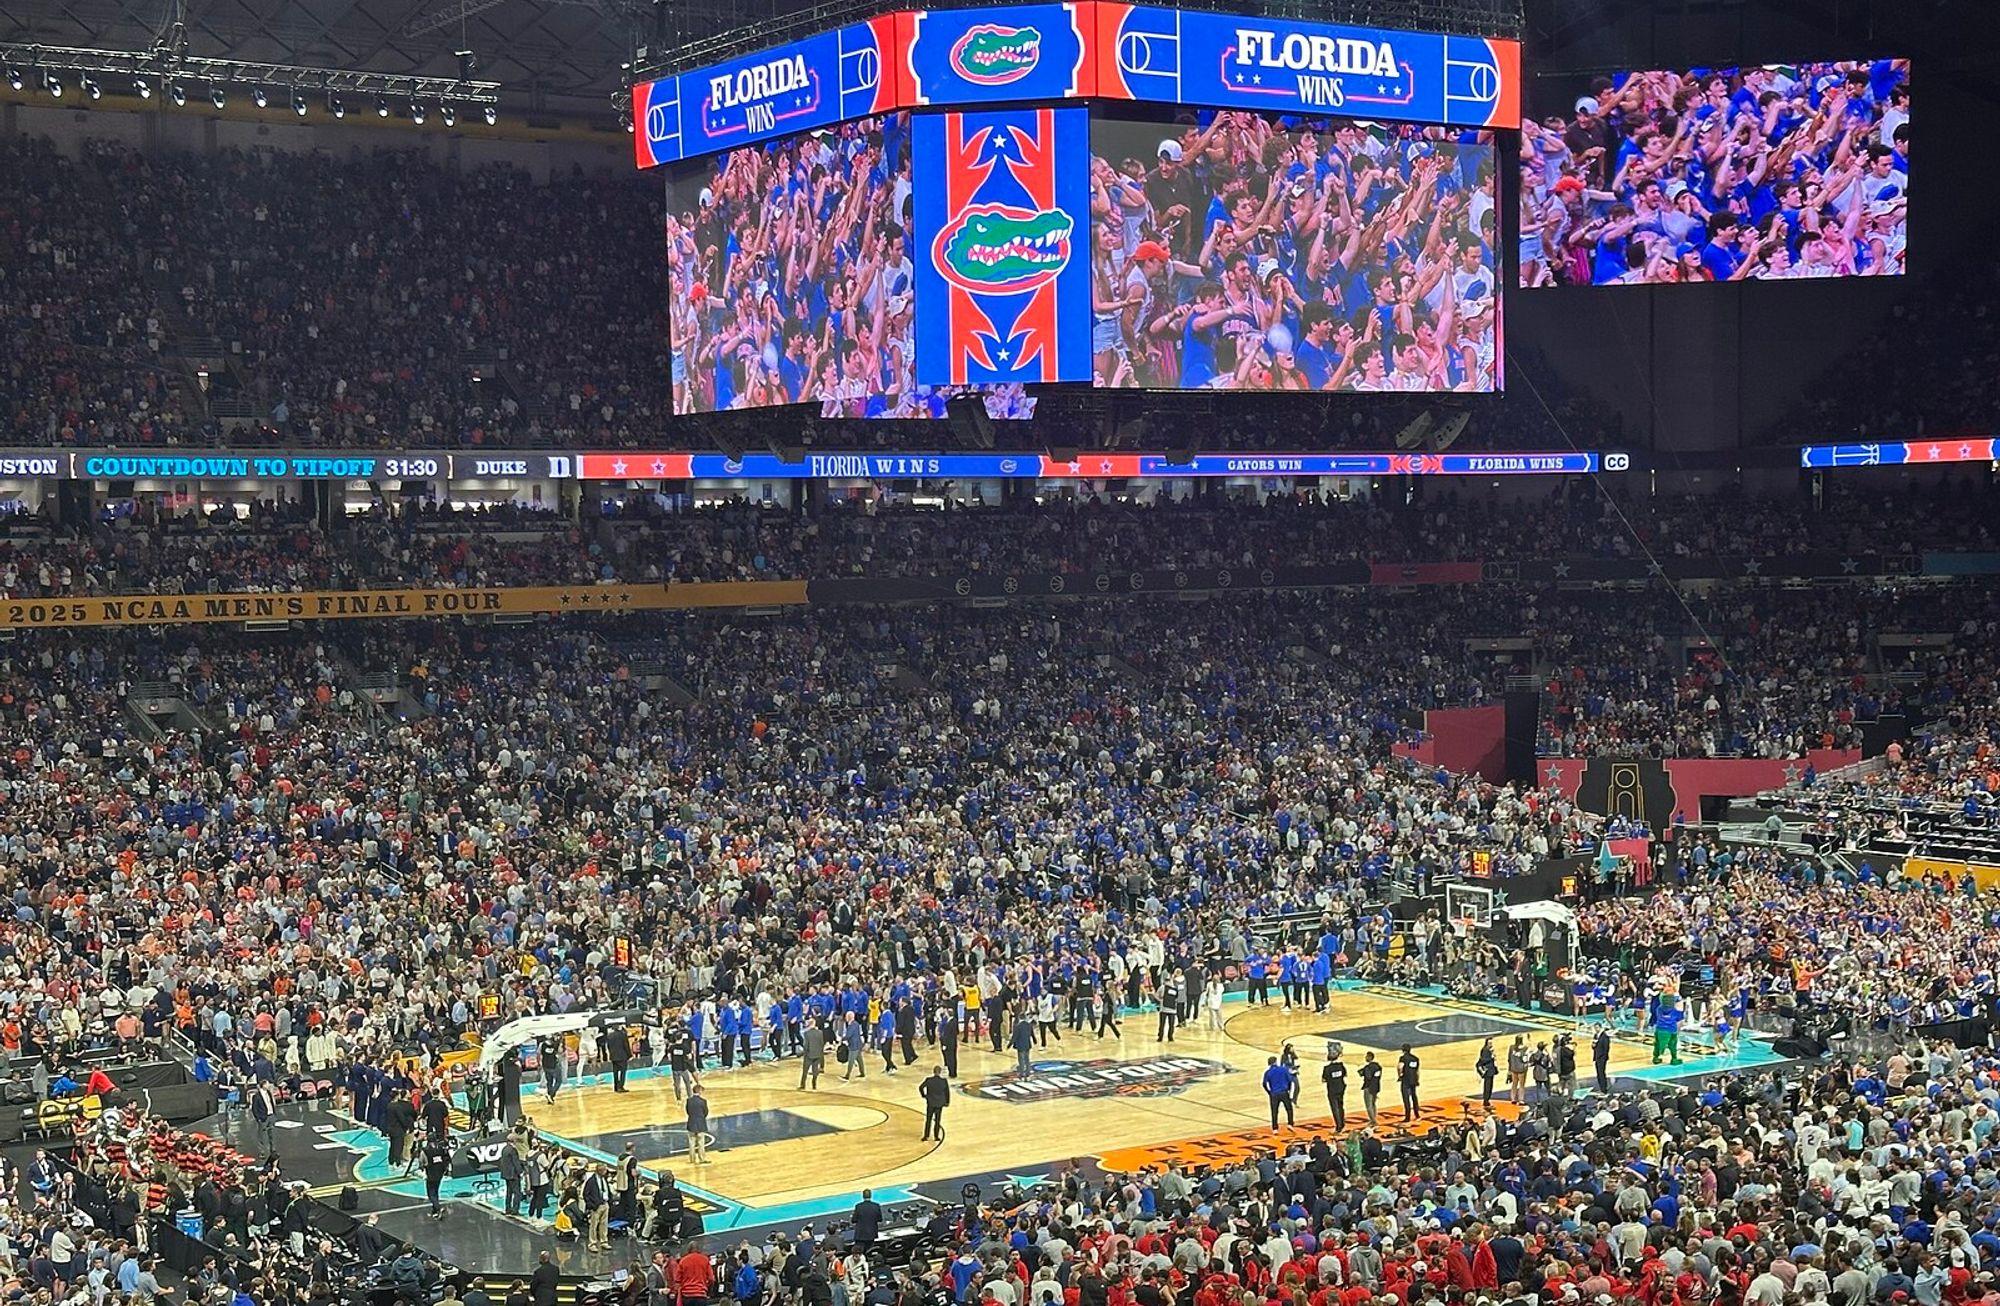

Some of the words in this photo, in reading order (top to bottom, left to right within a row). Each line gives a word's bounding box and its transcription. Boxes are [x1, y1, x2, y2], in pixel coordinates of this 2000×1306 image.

[1235, 29, 1399, 78] FLORIDA
[709, 54, 809, 111] FLORIDA
[1296, 74, 1344, 107] WINS
[745, 101, 776, 134] WINS
[86, 458, 249, 477] COUNTDOWN
[254, 459, 287, 477] TO
[292, 458, 377, 476] TIPOFF
[386, 459, 438, 477] 31:30
[475, 460, 527, 475] DUKE
[811, 455, 870, 477] FLORIDA
[875, 459, 940, 474] WINS
[1227, 459, 1275, 471] GATORS
[1278, 459, 1302, 471] WIN
[1469, 458, 1525, 471] FLORIDA
[1529, 457, 1564, 470] WINS
[1606, 456, 1628, 468] CC
[8, 603, 88, 623] 2025
[102, 600, 191, 620] NCAA
[204, 597, 304, 617] MEN'S
[317, 594, 411, 615] FINAL
[423, 592, 503, 612] FOUR
